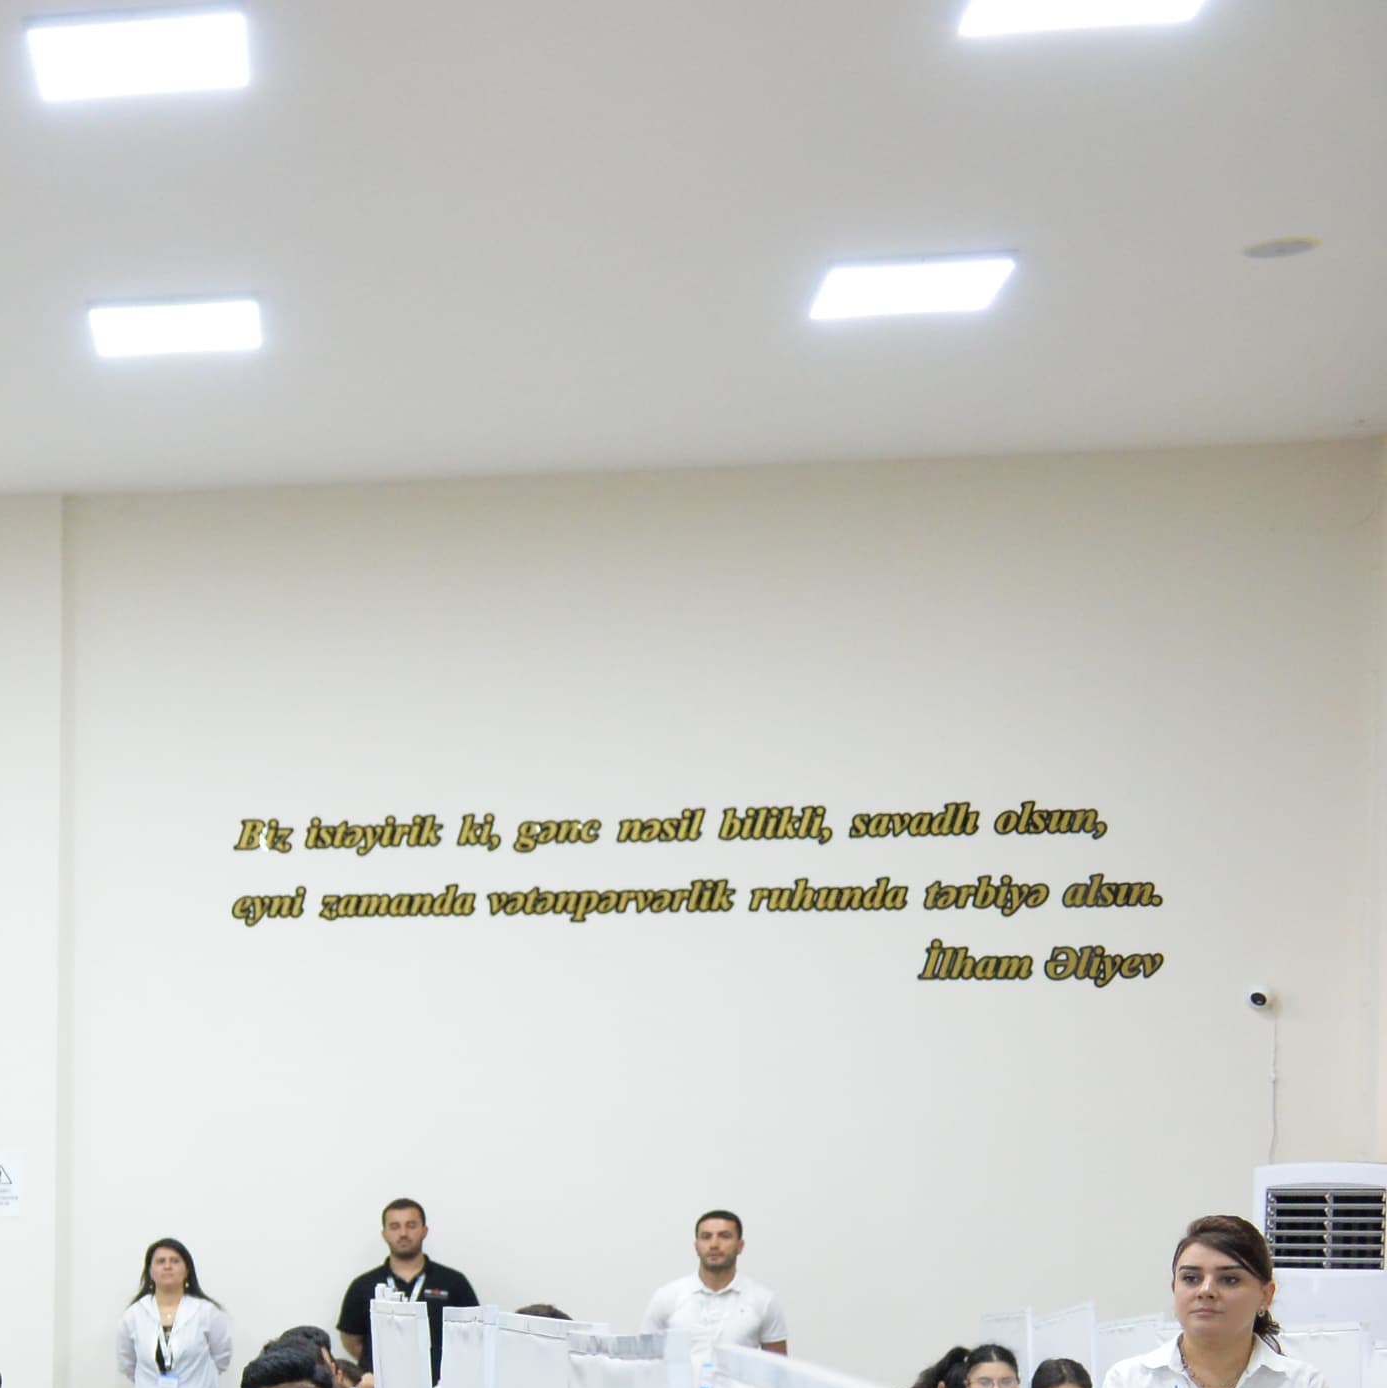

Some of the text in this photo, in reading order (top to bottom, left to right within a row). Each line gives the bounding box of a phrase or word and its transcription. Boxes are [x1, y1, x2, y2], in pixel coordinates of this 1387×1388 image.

[232, 799, 1110, 857] Biz istəyirik ki, gənc nəsil bilikli, savadlı olsun,
[231, 871, 1165, 929] eyni zamanda vətənpərvərlik ruhunda tərbiyə alsın.
[915, 936, 1166, 990] İlham Əliyev
